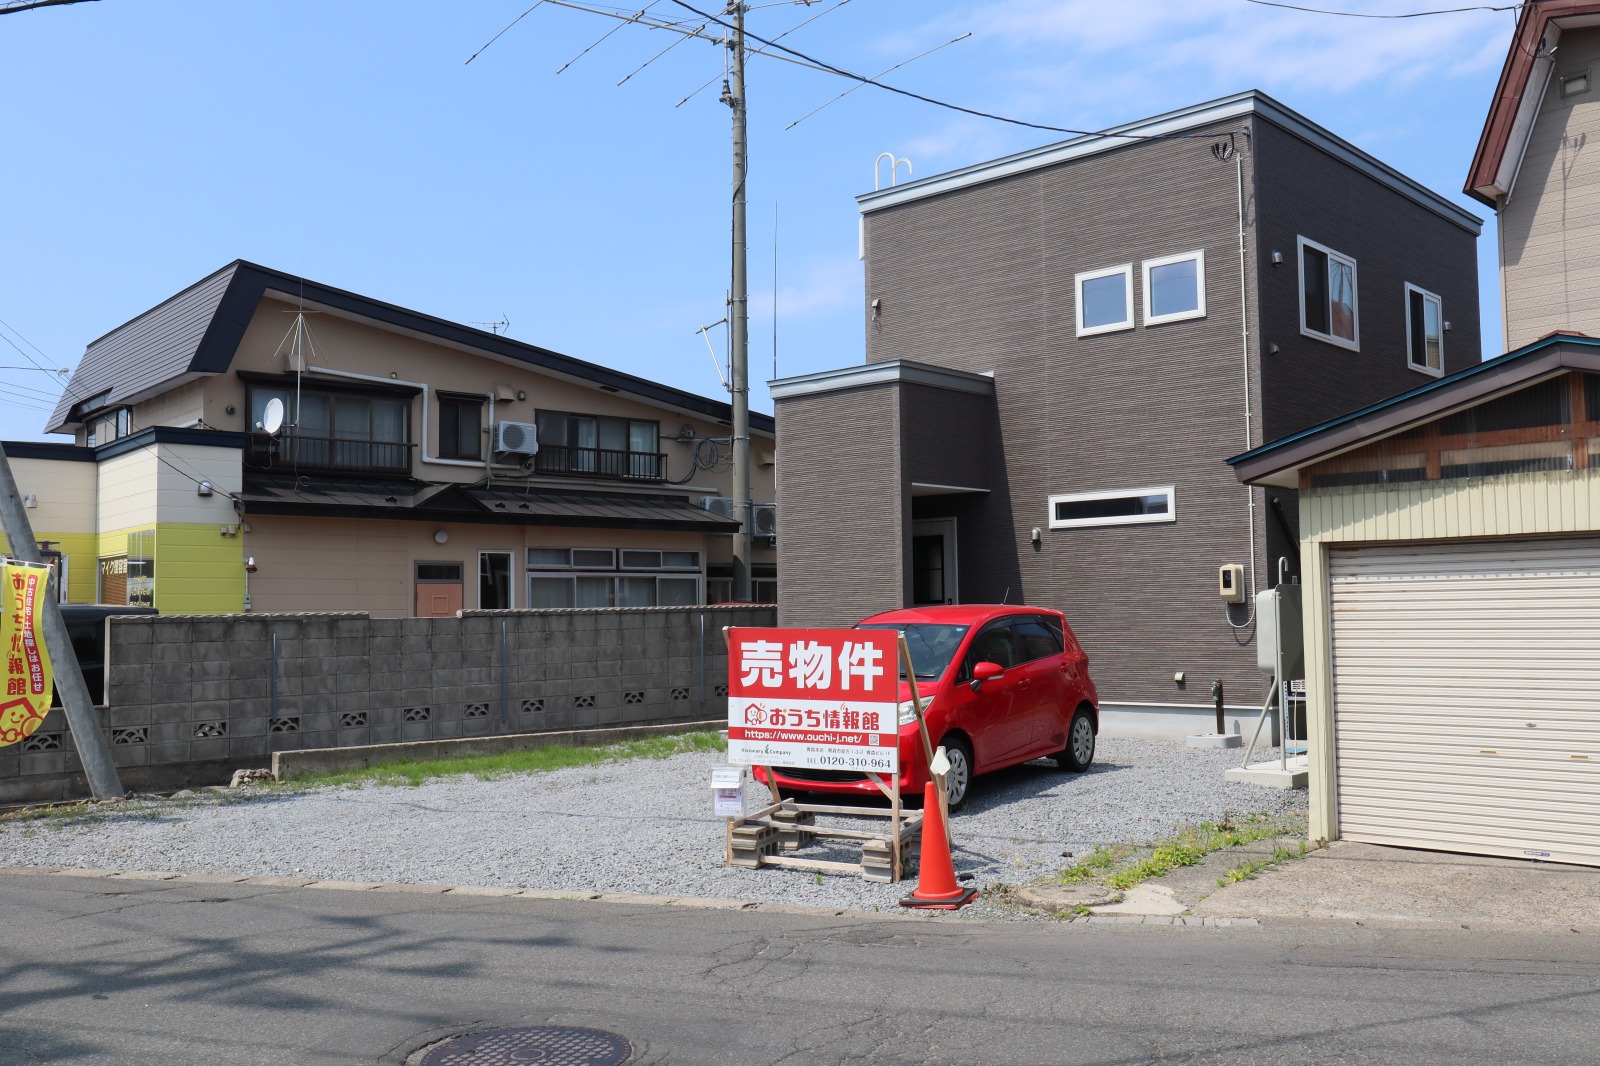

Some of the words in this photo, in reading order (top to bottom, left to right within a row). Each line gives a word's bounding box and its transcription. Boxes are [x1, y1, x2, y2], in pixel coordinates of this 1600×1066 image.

[740, 640, 883, 691] 売物件
[770, 707, 880, 731] おうち情報館
[744, 730, 862, 744] https://www.ouchi-j.net/
[741, 747, 763, 755] Visionary
